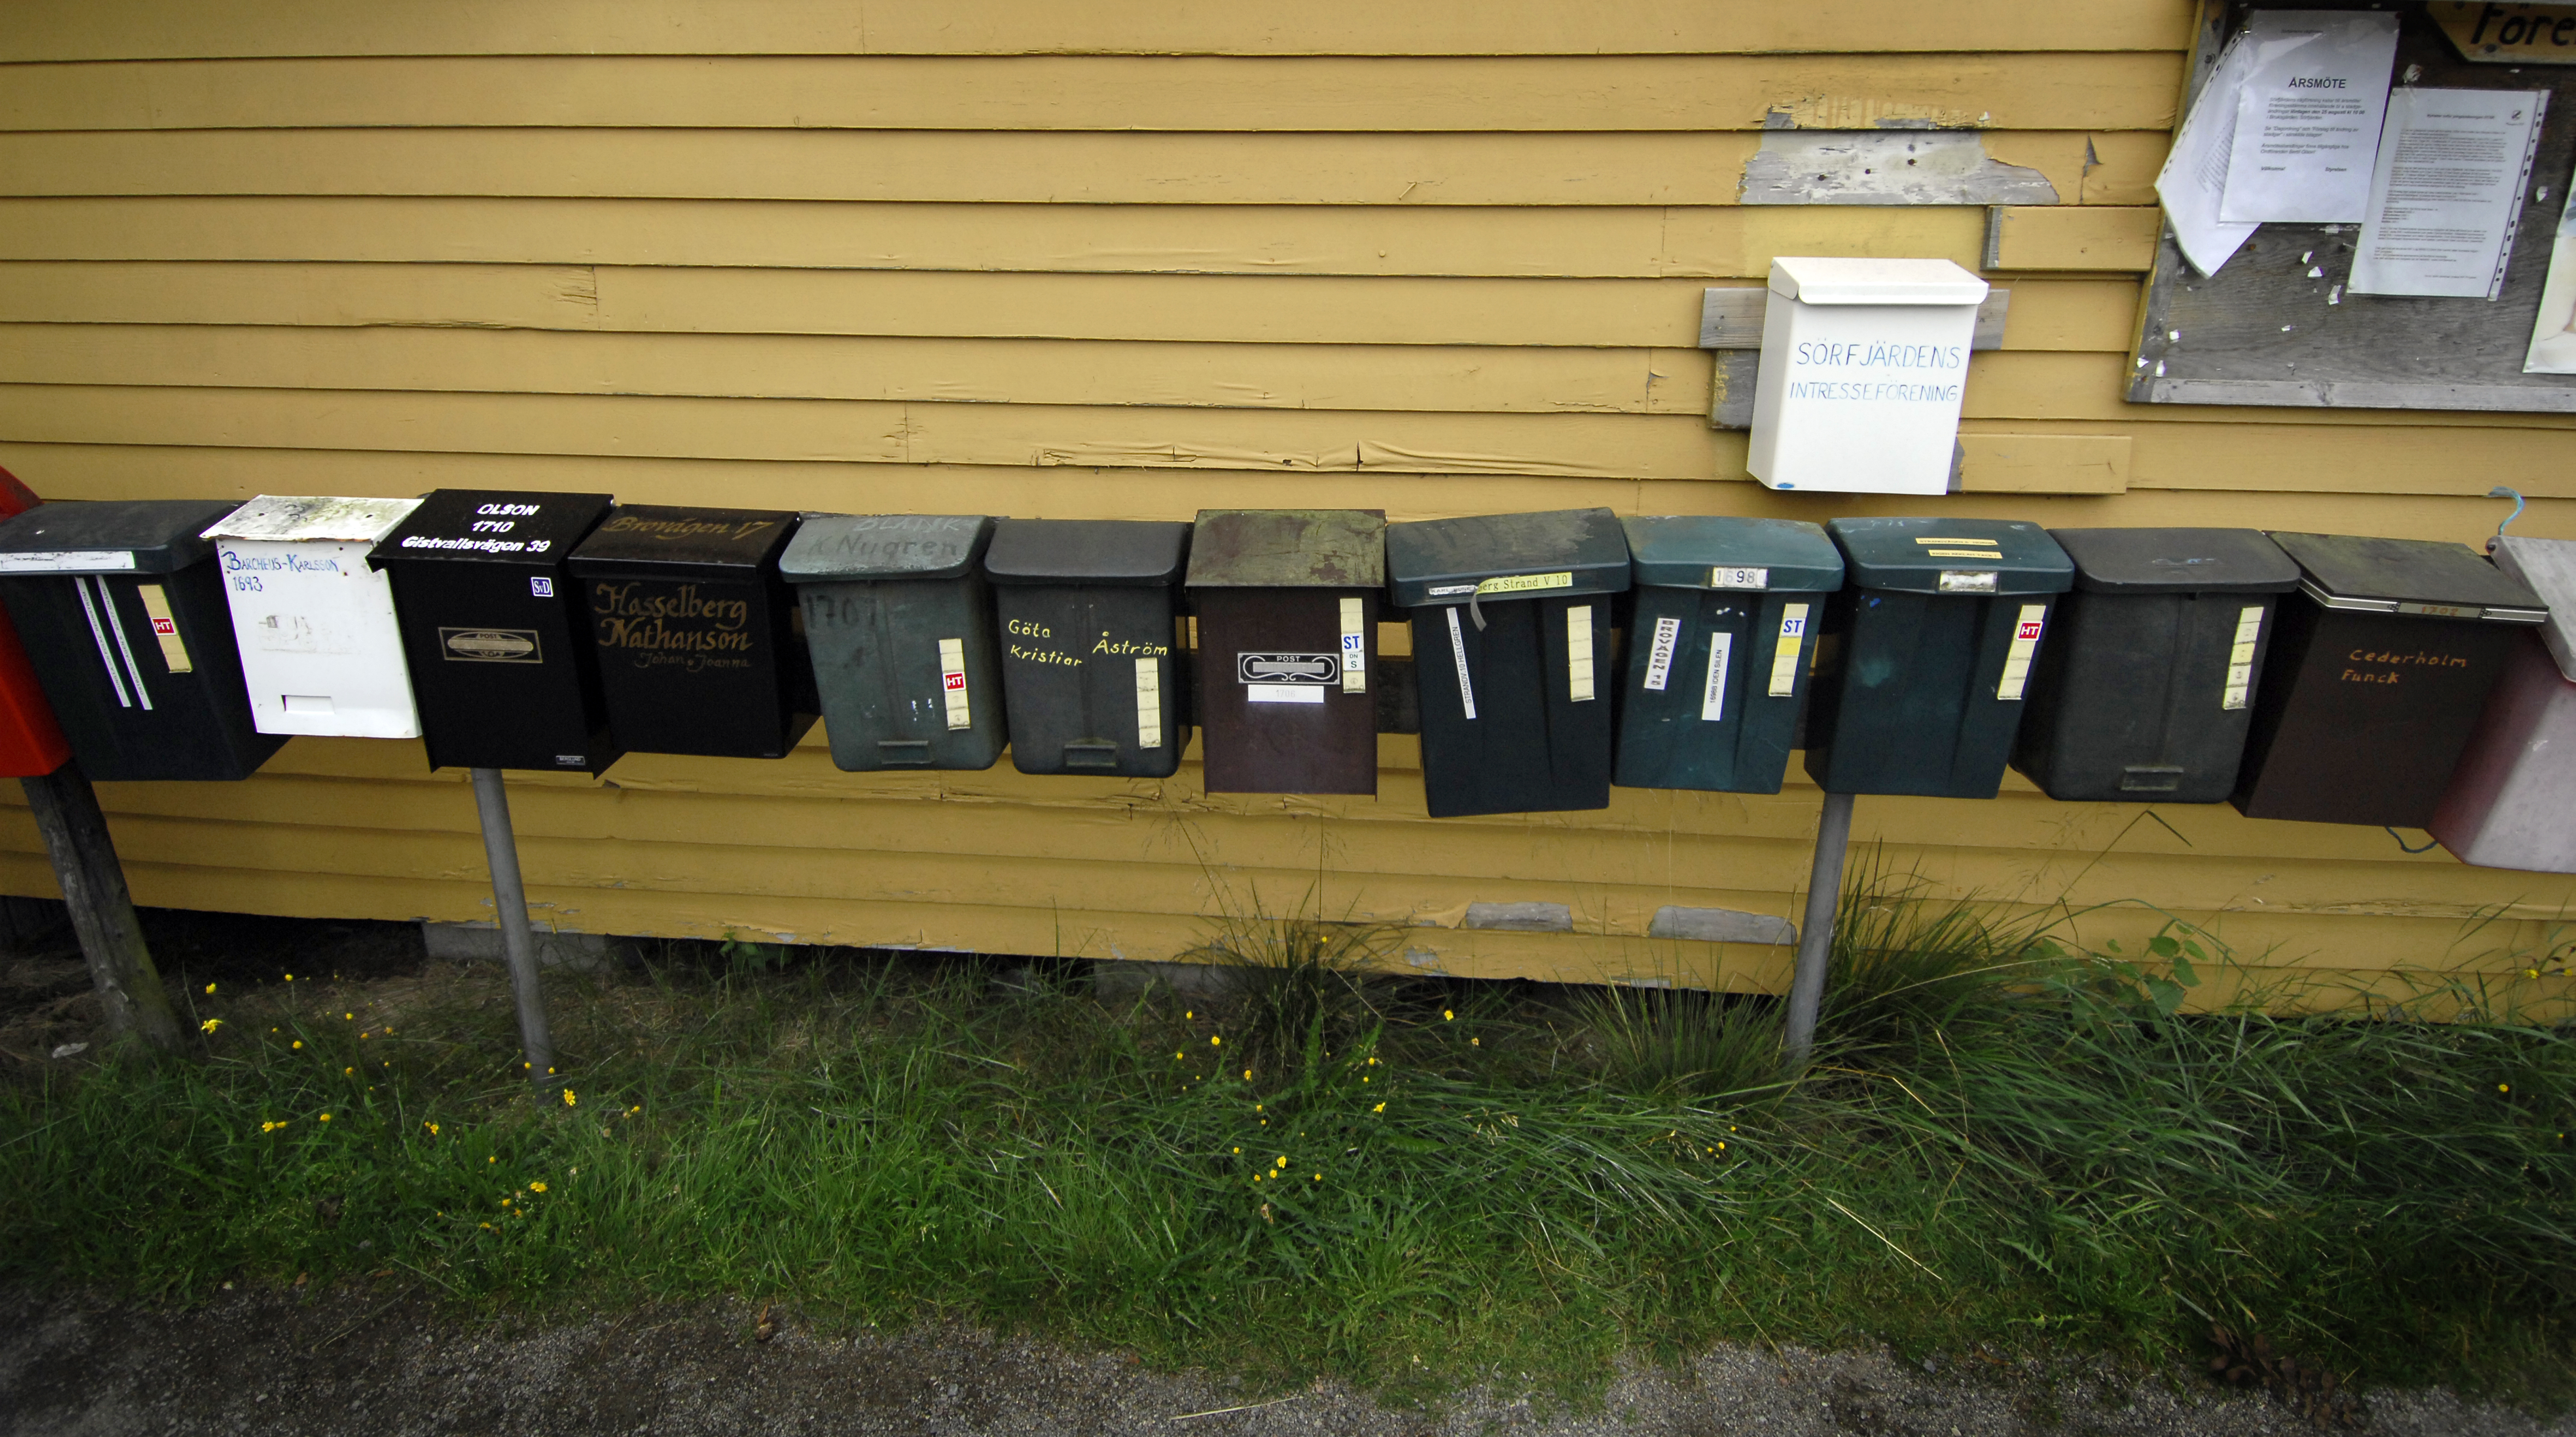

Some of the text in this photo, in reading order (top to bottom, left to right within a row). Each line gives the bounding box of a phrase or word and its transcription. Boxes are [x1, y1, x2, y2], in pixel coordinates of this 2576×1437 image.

[2470, 2, 2576, 46] Före
[2288, 76, 2346, 88] ÅRSMÖTE
[1797, 337, 1961, 369] SÖRFJÄRDENS
[1790, 379, 1958, 402] INTRESSEFÖRENING
[477, 504, 540, 516] OLSON
[472, 521, 515, 532] 1710
[731, 521, 774, 540] 17
[402, 536, 551, 553] Gistvallsvägen 39
[233, 576, 263, 591] 1693
[534, 581, 550, 594] SvD
[1504, 578, 1538, 589] Strand
[1544, 576, 1550, 585] V
[1556, 575, 1567, 585] 10
[595, 583, 747, 630] Hasselberg
[155, 620, 172, 630] HT
[1008, 619, 1051, 638] Göta
[1783, 620, 1802, 634] ST
[2020, 626, 2038, 635] HT
[598, 617, 753, 651] Nathanson
[1093, 631, 1168, 656] Åström
[1343, 636, 1359, 649] ST
[1452, 627, 1463, 663] HELLGREN
[634, 652, 685, 668] Johan
[2350, 649, 2467, 667] Cederholm
[947, 675, 962, 686] HT
[2341, 669, 2399, 684] Funck
[1276, 689, 1295, 698] 1706
